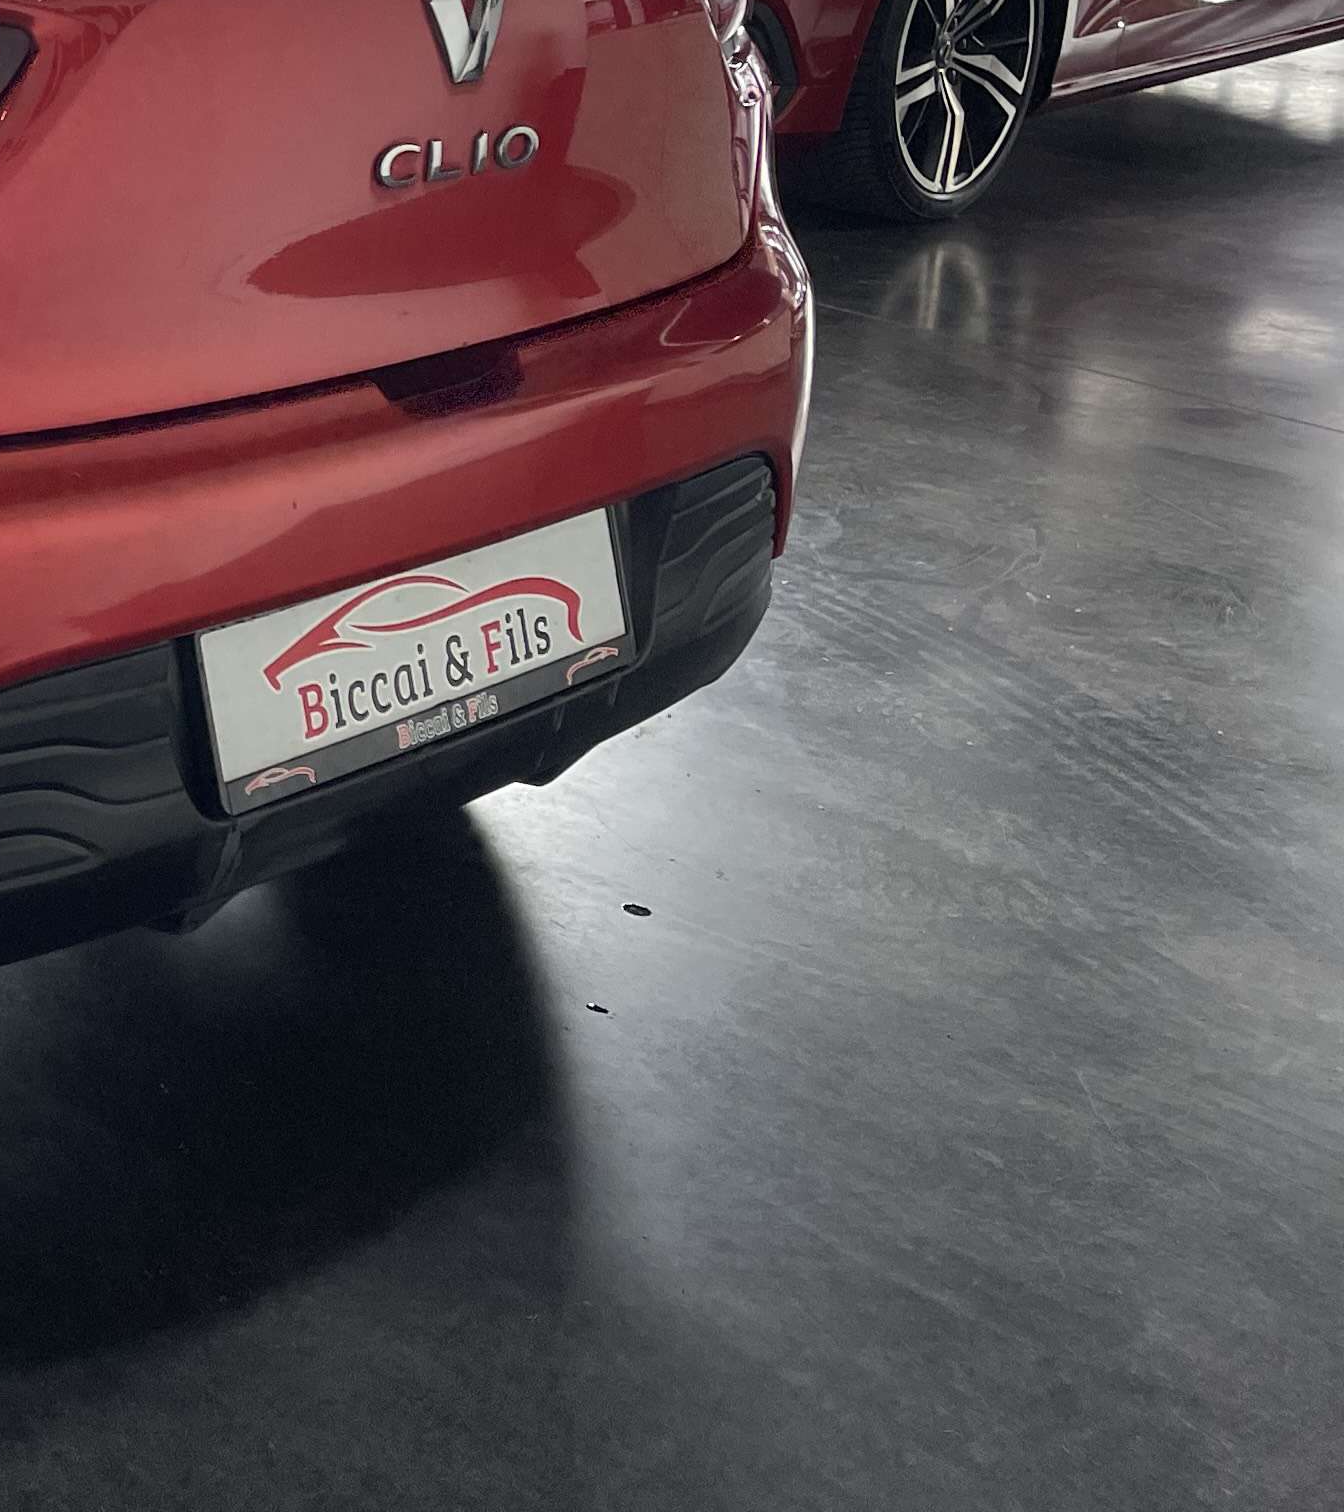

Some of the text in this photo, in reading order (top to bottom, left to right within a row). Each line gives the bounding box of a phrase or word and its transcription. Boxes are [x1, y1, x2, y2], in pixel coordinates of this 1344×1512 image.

[375, 124, 540, 189] CLIO
[297, 607, 552, 739] Biccai & Fils
[396, 692, 499, 749] Biccai & Fils
